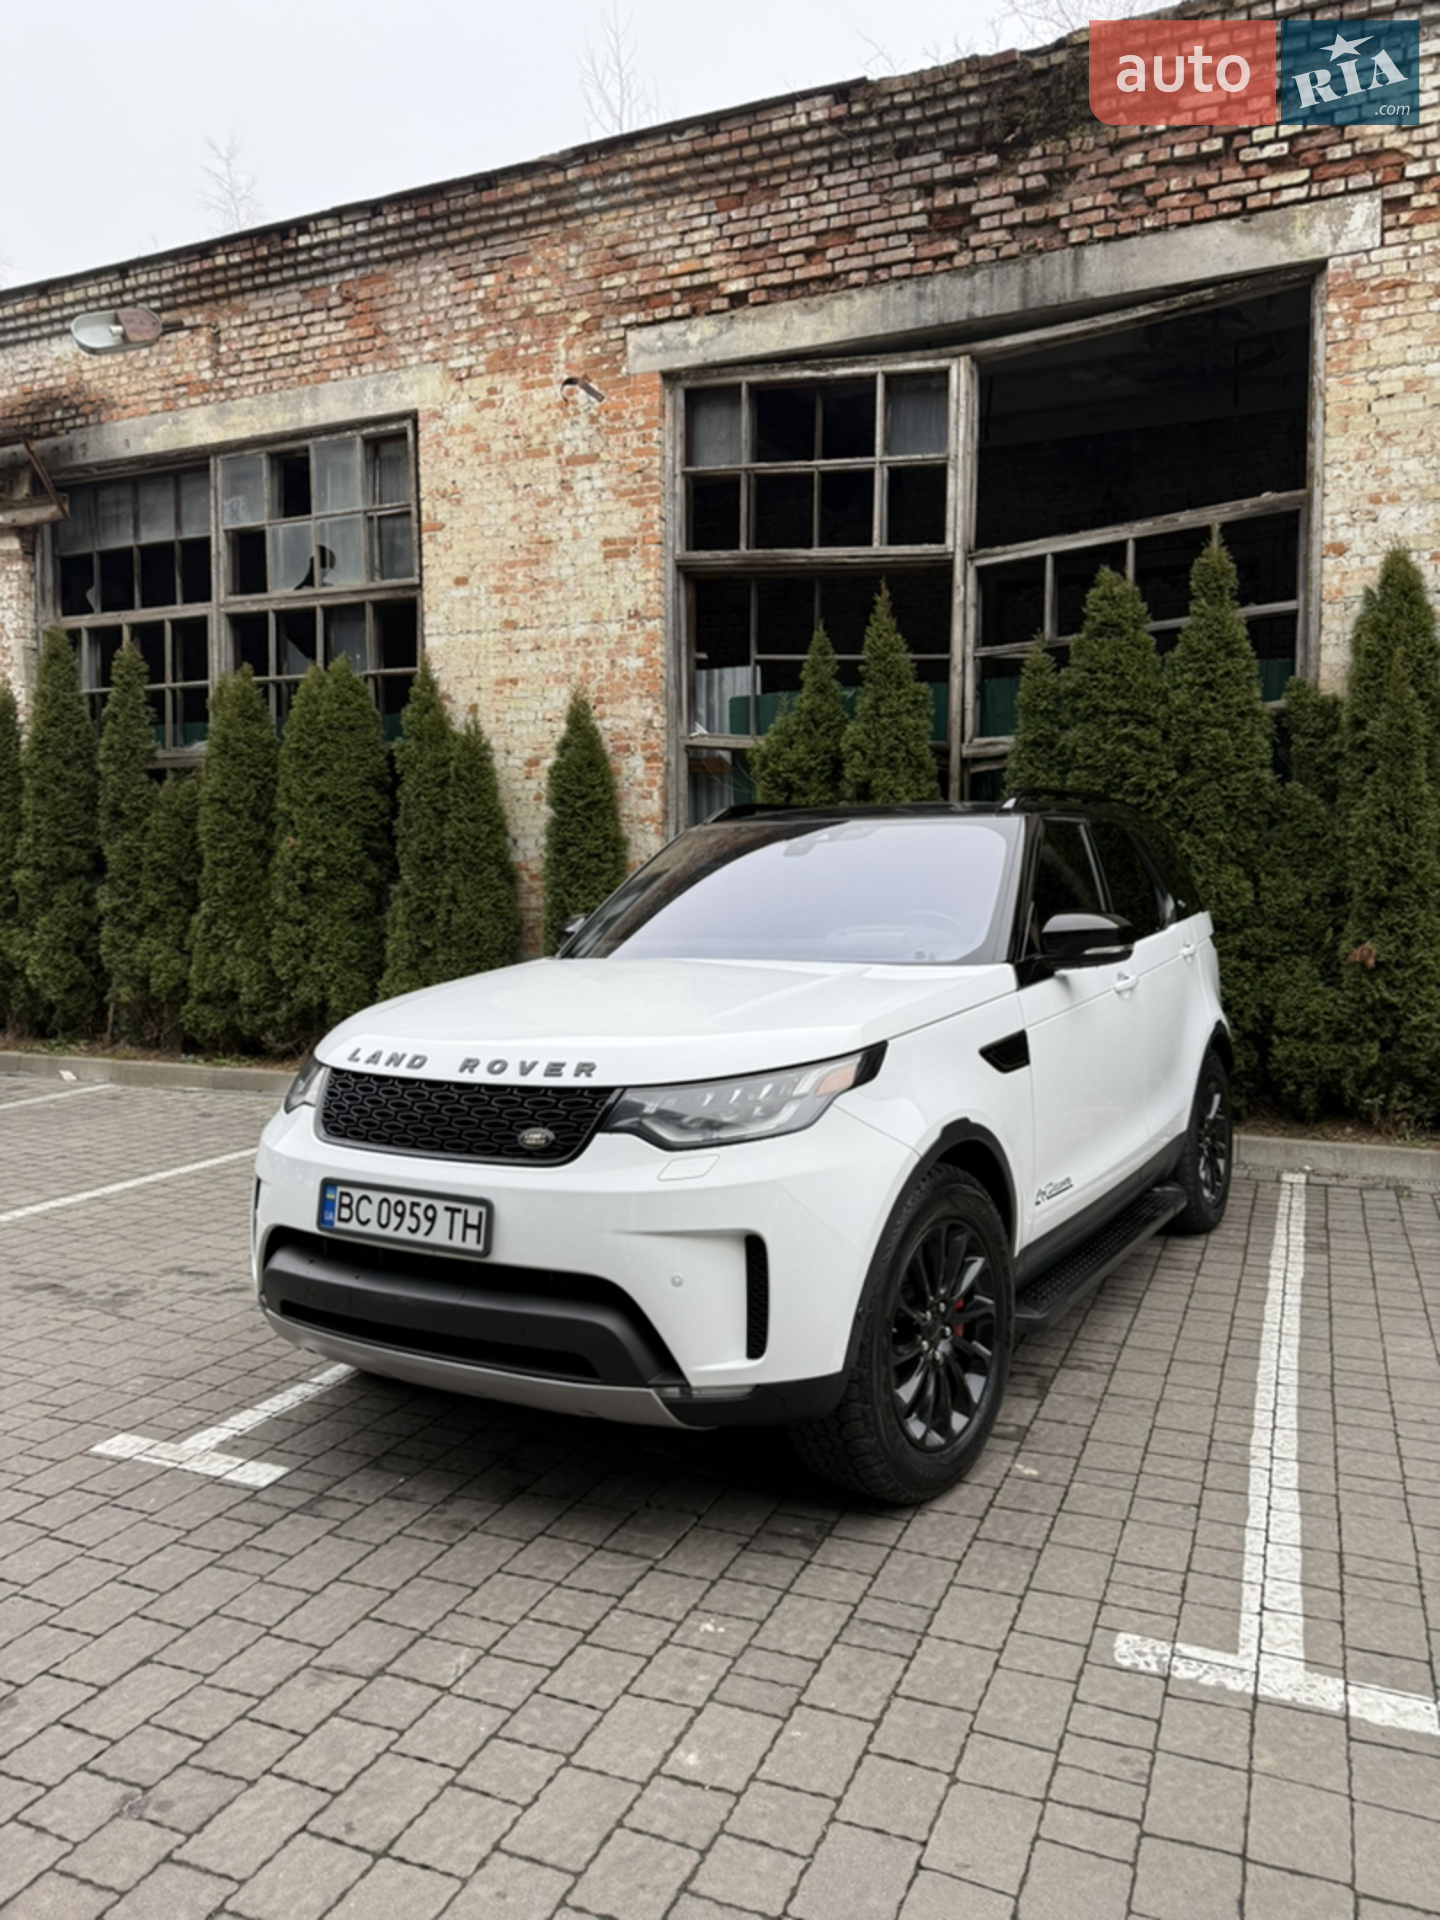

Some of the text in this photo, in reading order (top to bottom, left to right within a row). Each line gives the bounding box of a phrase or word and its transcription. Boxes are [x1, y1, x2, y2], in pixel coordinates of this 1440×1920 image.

[347, 1047, 597, 1078] LAND ROVER
[337, 1190, 483, 1245] BC 0959 TH
